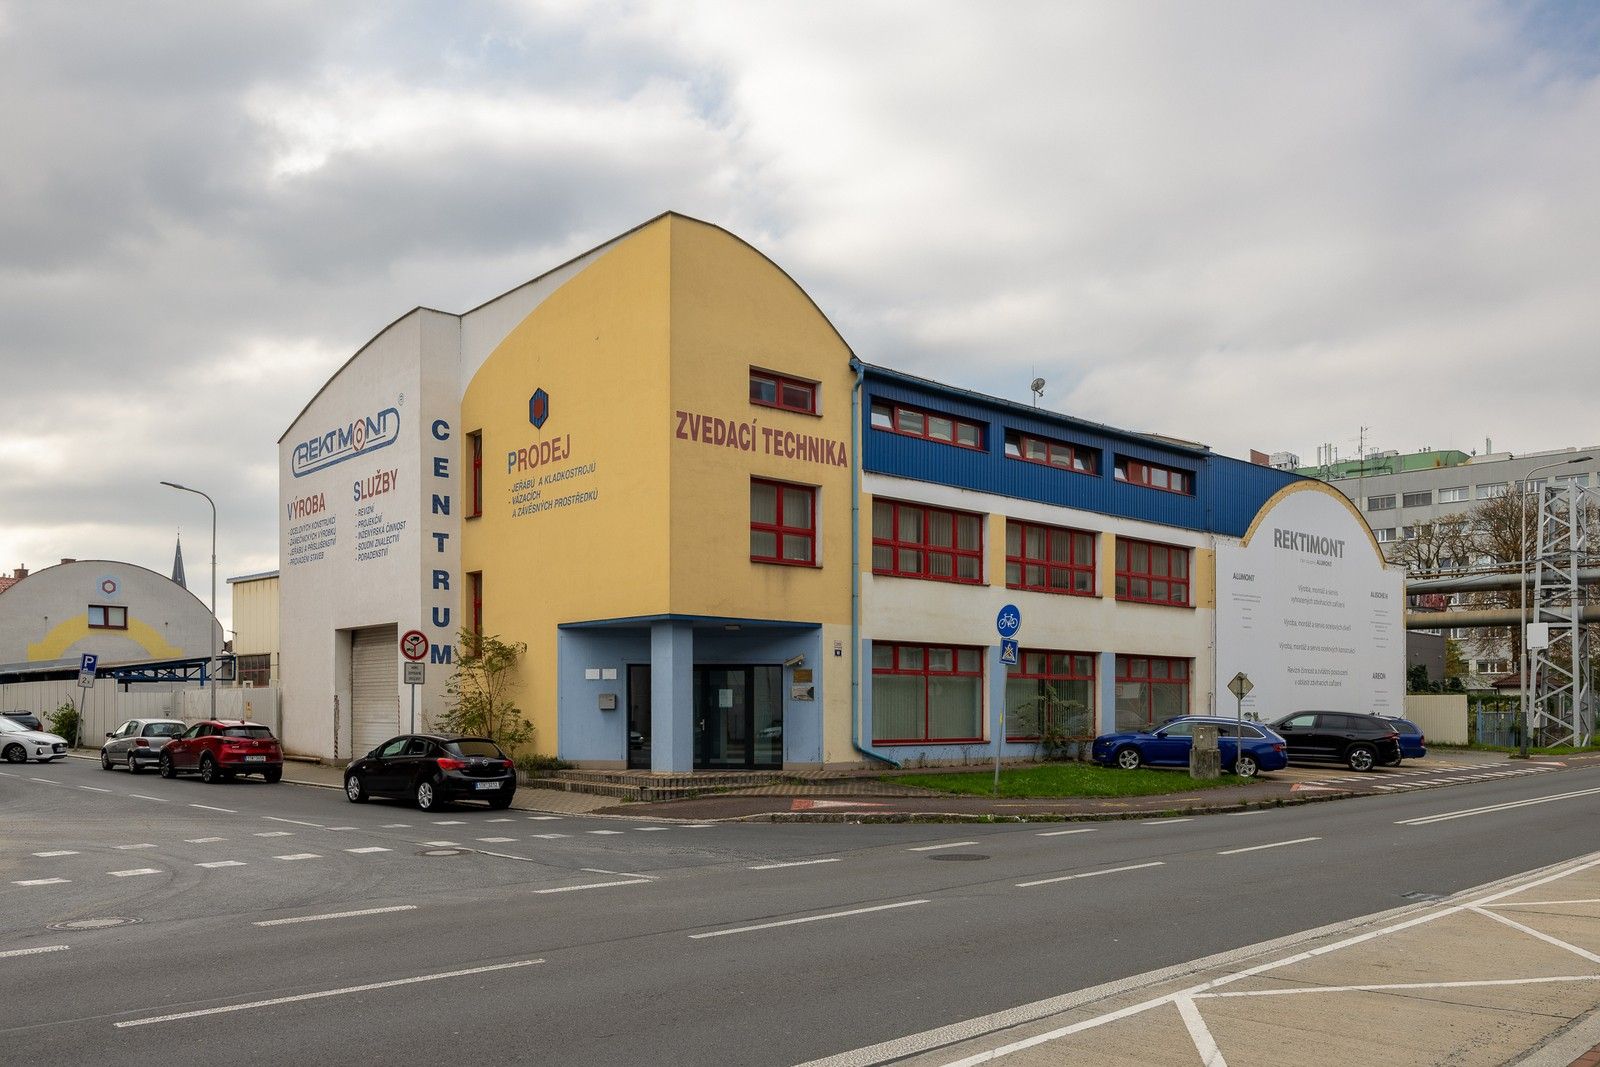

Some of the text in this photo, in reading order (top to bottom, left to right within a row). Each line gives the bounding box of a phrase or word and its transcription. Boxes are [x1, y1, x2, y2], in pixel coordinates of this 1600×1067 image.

[508, 434, 571, 475] PRODEJ
[676, 411, 848, 468] ZVEDACÍ TECHNIKA
[353, 469, 399, 502] SLUŽBY
[286, 492, 326, 521] VÝROBA
[431, 419, 452, 665] CENTRUM
[1273, 527, 1346, 559] REKTIMONT
[84, 655, 95, 667] P
